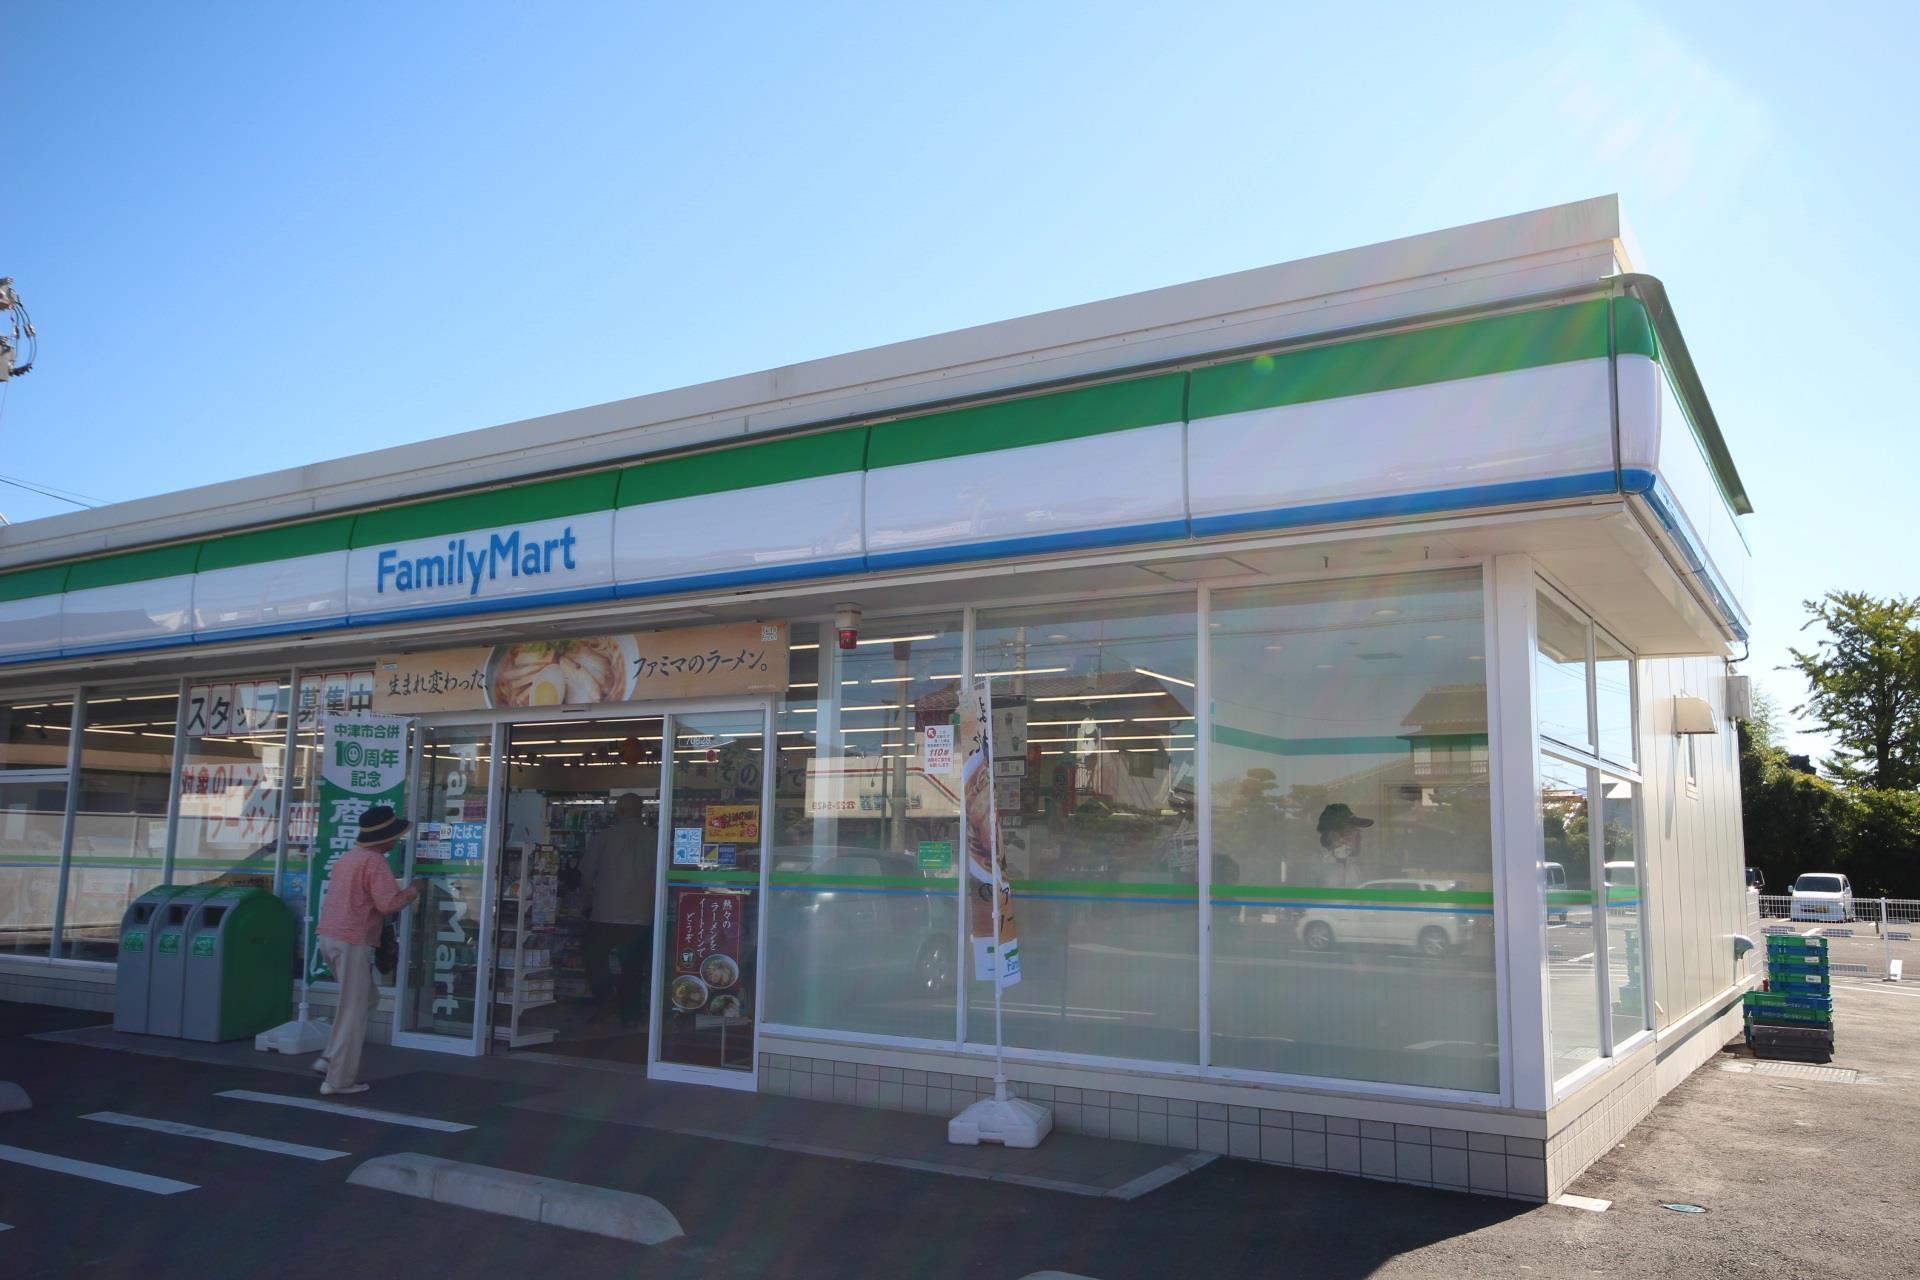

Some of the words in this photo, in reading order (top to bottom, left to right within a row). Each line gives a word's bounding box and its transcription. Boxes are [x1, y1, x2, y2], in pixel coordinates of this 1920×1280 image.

[377, 526, 576, 596] FamilyMart
[632, 649, 768, 679] ファミマのラーメン。
[334, 722, 400, 739] 中津市合併
[335, 740, 400, 769] 10周年
[350, 770, 382, 788] 記念
[452, 824, 483, 840] たばこ
[454, 841, 479, 859] お酒
[685, 911, 696, 944] どうぞ
